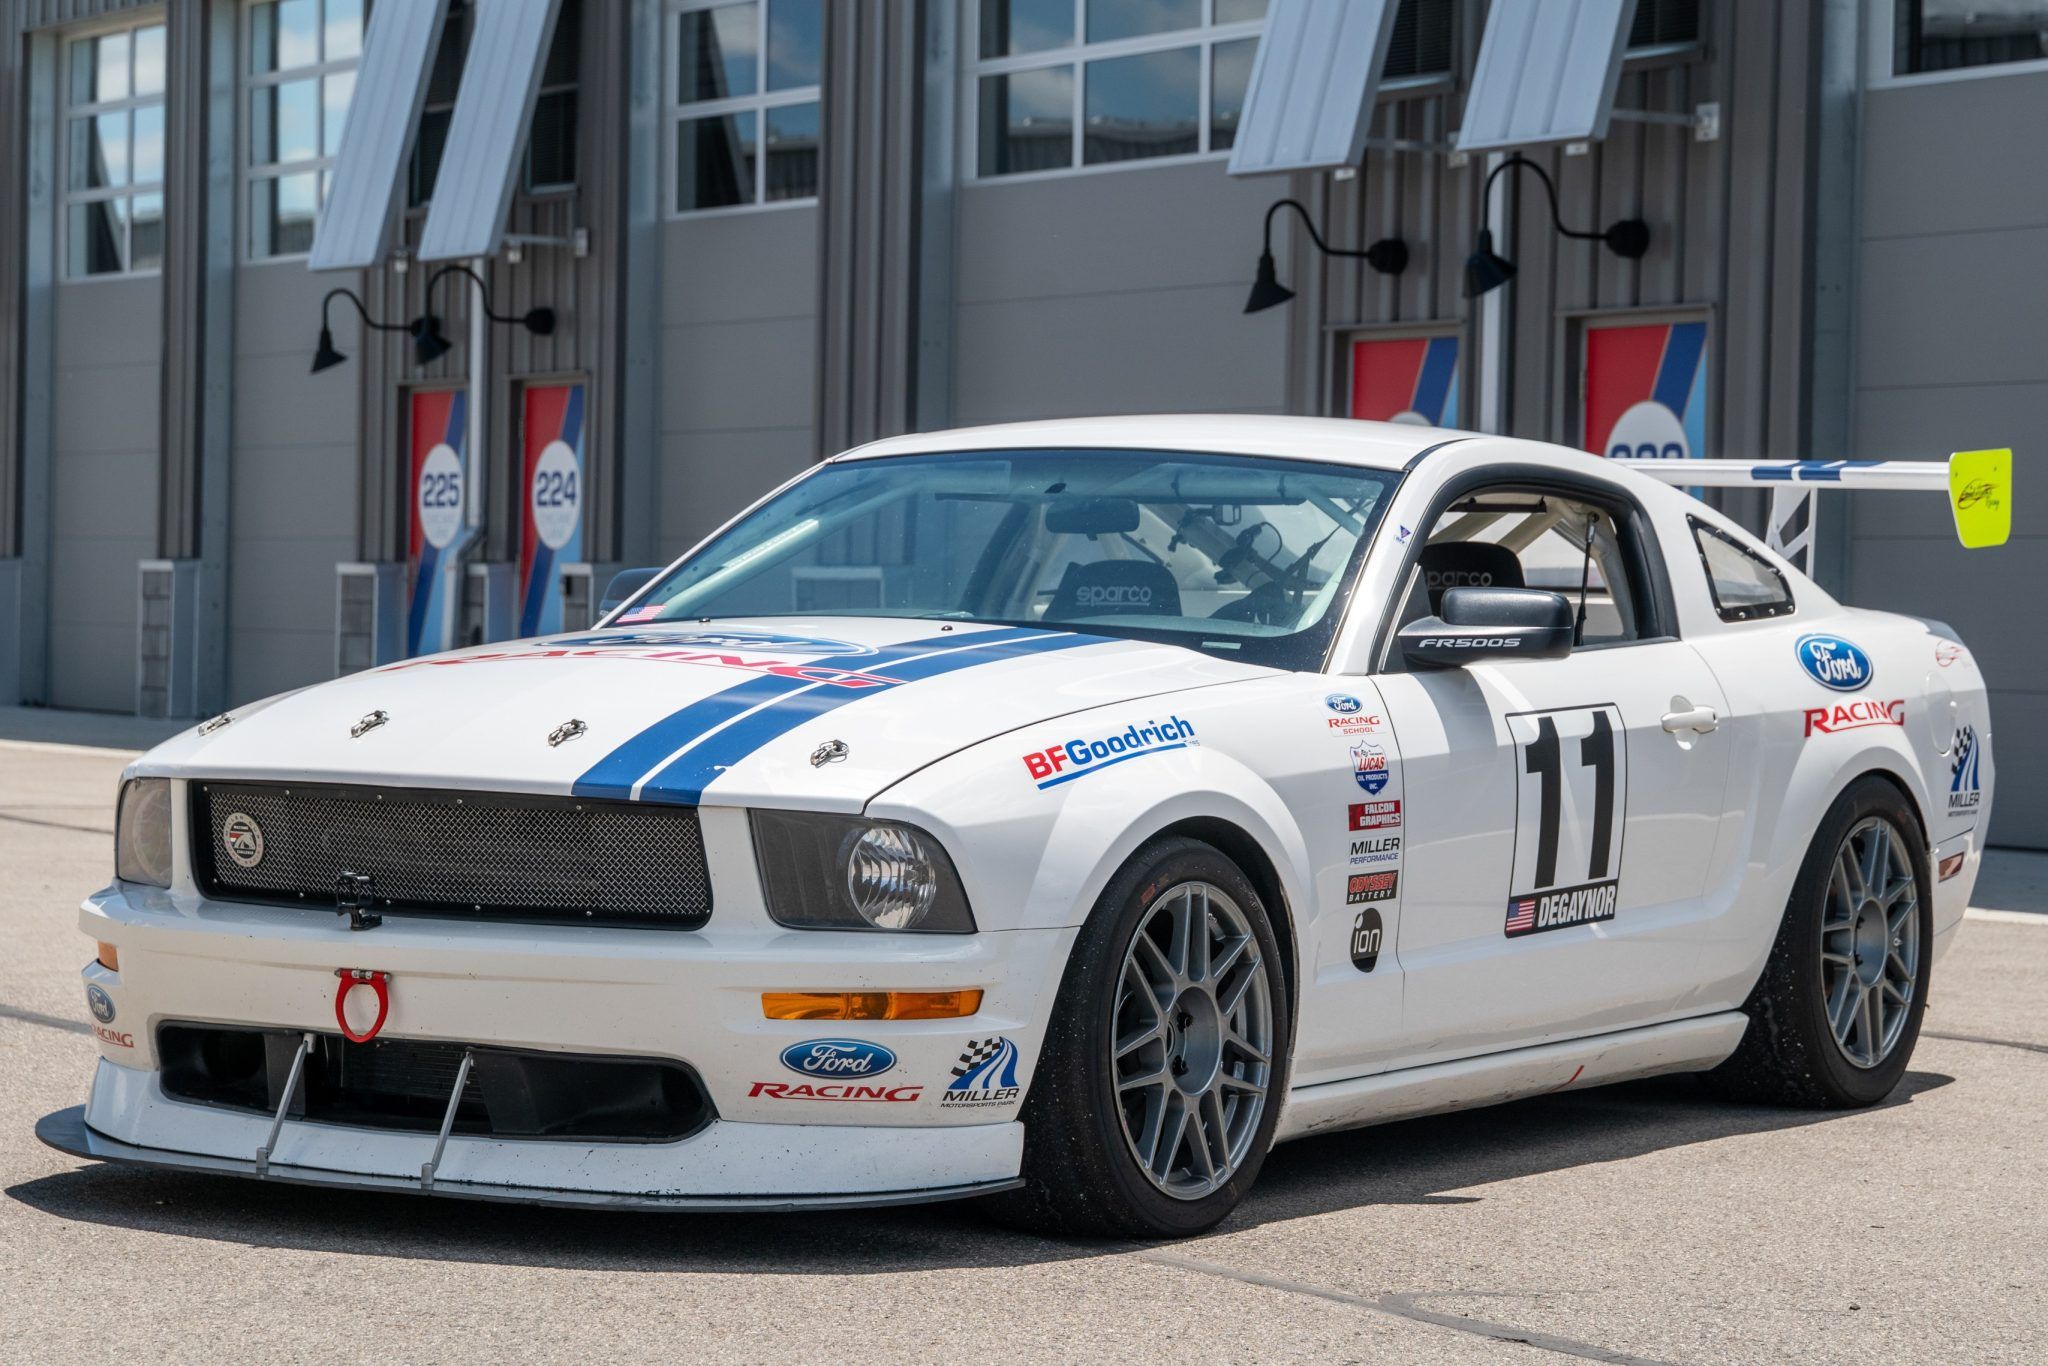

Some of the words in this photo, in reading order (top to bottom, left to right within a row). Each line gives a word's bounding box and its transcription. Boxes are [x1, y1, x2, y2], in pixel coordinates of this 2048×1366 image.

[423, 473, 460, 507] 225
[536, 471, 577, 507] 224
[1427, 570, 1493, 588] parco
[1076, 585, 1152, 607] sparco
[1418, 637, 1522, 648] FR500S
[375, 650, 908, 689] RACING
[1809, 641, 1862, 682] Ford
[1332, 695, 1357, 711] Ford
[1328, 715, 1380, 728] RACING
[1803, 700, 1905, 738] RACING
[1343, 727, 1375, 735] SCHOOL
[1023, 716, 1195, 780] BFGoodrich
[1358, 757, 1385, 772] LUCAS
[1357, 774, 1365, 782] OIL
[1365, 773, 1388, 782] PRODUCTS
[1364, 802, 1395, 814] FALCON
[1525, 710, 1614, 889] 11
[1948, 791, 1980, 809] MILLER
[1359, 813, 1401, 827] GRAPHICS
[1350, 837, 1400, 856] MILLER
[1350, 853, 1399, 865] PERFORMANCE
[1349, 873, 1397, 894] ODYSSEY
[1348, 889, 1392, 902] BATTERY
[1537, 885, 1616, 928] DEGAYNOR
[1353, 913, 1381, 953] ion
[90, 988, 109, 1017] Ford
[803, 1044, 874, 1072] Ford
[748, 1081, 924, 1102] RACING
[942, 1088, 1019, 1101] MILLER
